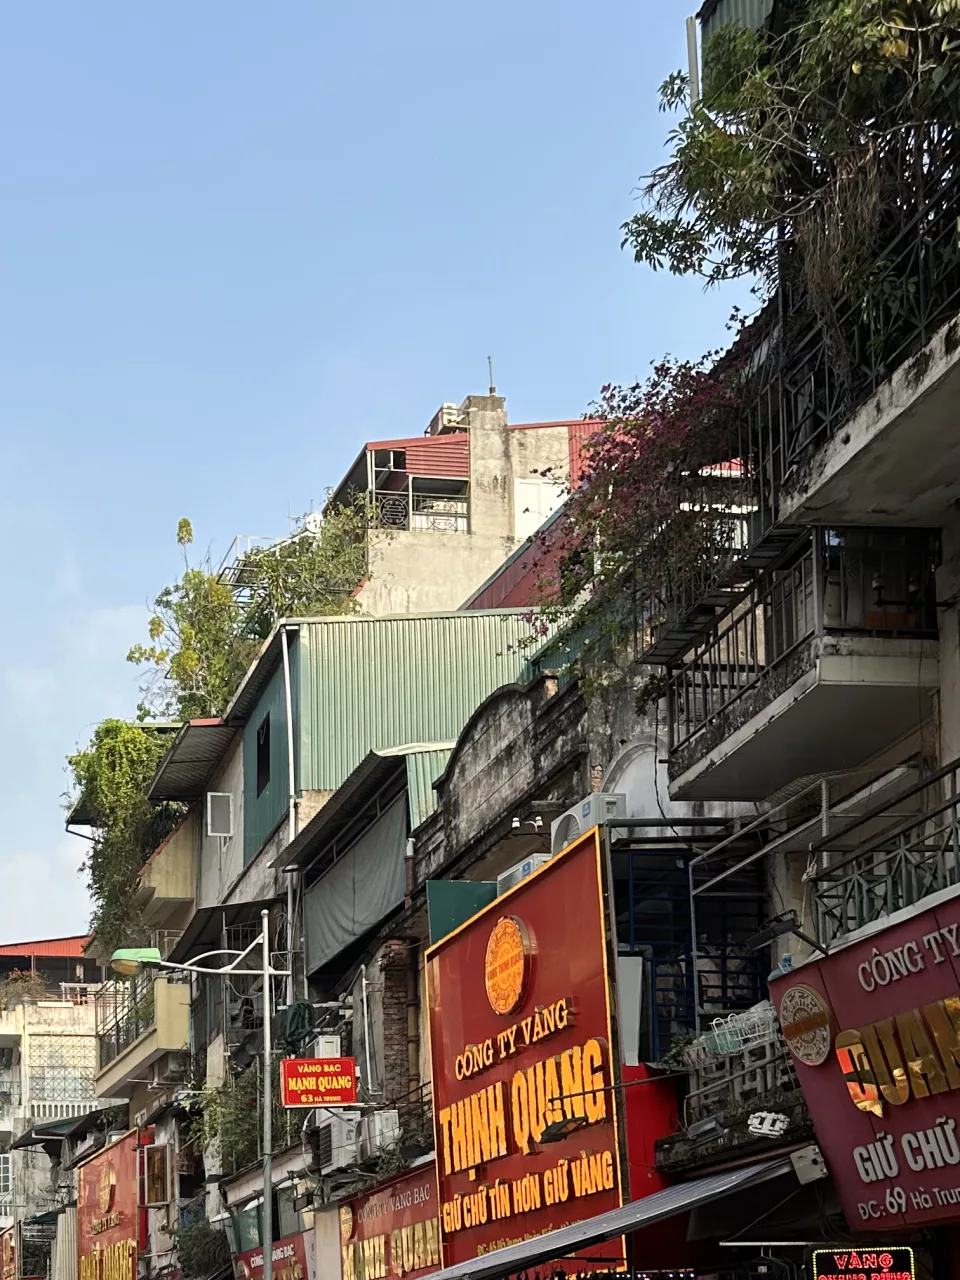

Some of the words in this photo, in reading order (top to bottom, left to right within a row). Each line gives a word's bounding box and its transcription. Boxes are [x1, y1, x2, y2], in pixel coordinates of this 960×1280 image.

[858, 940, 925, 992] CÔNG
[923, 922, 960, 964] TY
[297, 1063, 322, 1073] VÀNG
[323, 1064, 341, 1074] BẠC
[455, 1038, 494, 1081] CÔNG
[497, 1025, 517, 1059] TY
[520, 997, 570, 1045] VÀNG
[835, 996, 960, 1118] QUAN
[288, 1076, 316, 1094] MẠNH
[318, 1076, 352, 1092] QUANG
[439, 1080, 508, 1181] THỊNH
[511, 1038, 607, 1156] QUANG
[853, 1130, 899, 1184] GIỮ
[901, 1115, 960, 1172] CHỮ
[391, 1190, 412, 1212] VÀNG
[413, 1184, 430, 1207] BẠC
[442, 1193, 461, 1233] GIỮ
[462, 1185, 487, 1227] CHỮ
[489, 1178, 511, 1220] TÍN
[512, 1174, 541, 1214] HƠN
[543, 1156, 569, 1206] GIỮ
[571, 1150, 614, 1197] VÀNG
[858, 1201, 886, 1220] ĐC:
[885, 1187, 907, 1214] 69
[910, 1191, 933, 1211] Hà
[272, 1247, 283, 1262] ÀNG
[391, 1217, 439, 1278] QUAN
[834, 1252, 894, 1269] VÀNG
